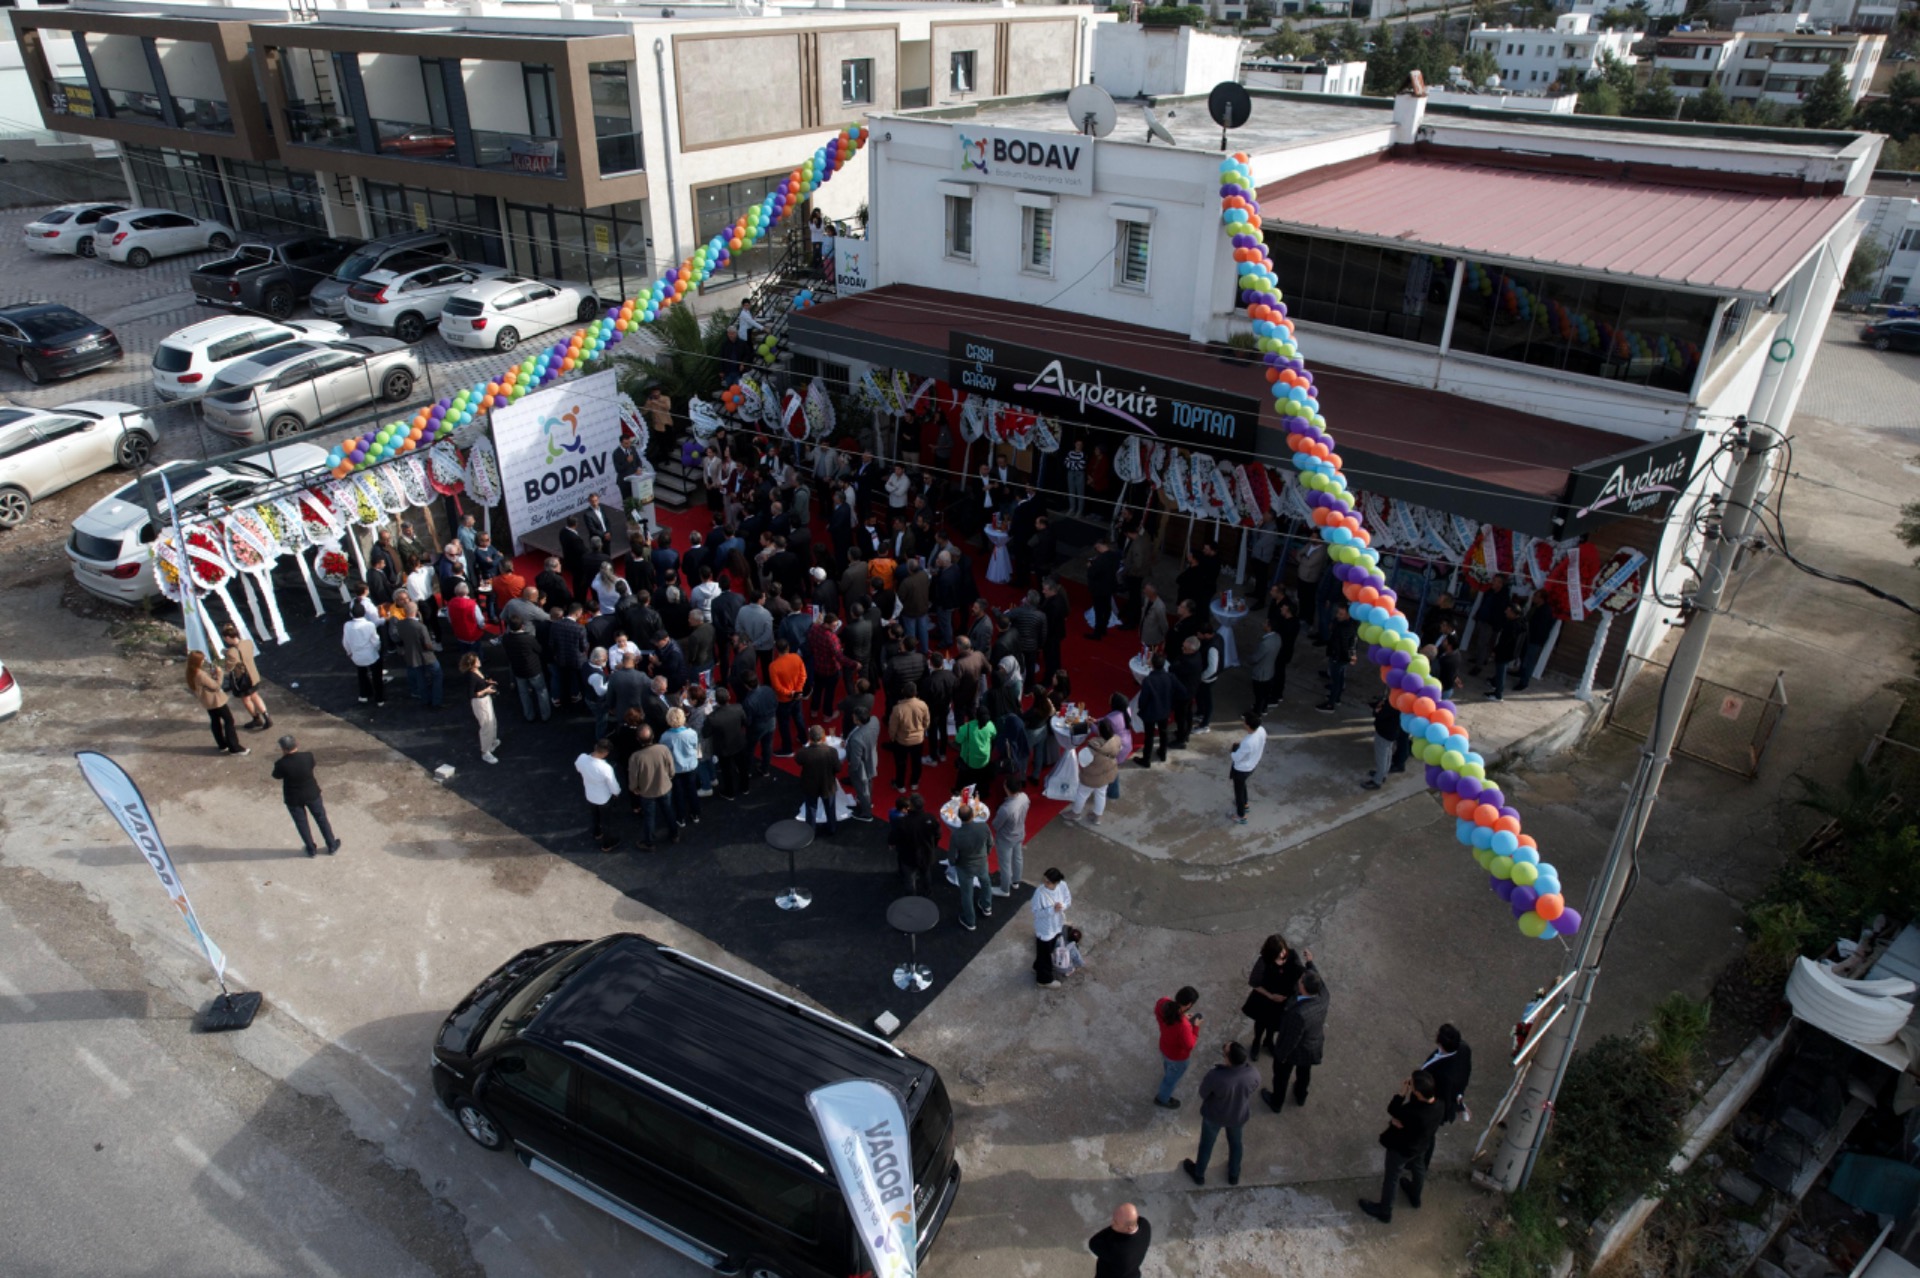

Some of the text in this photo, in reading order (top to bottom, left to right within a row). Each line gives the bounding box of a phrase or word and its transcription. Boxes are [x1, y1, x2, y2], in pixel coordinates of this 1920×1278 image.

[993, 137, 1081, 171] BODAV
[837, 274, 868, 289] BODAV
[965, 343, 994, 363] CASH
[962, 370, 997, 391] CARRY
[976, 361, 984, 373] &
[1026, 359, 1158, 418] Aydeniz
[1171, 401, 1236, 439] TOPTAN
[524, 451, 607, 504] BODAV
[1589, 451, 1686, 511] Aydeniz
